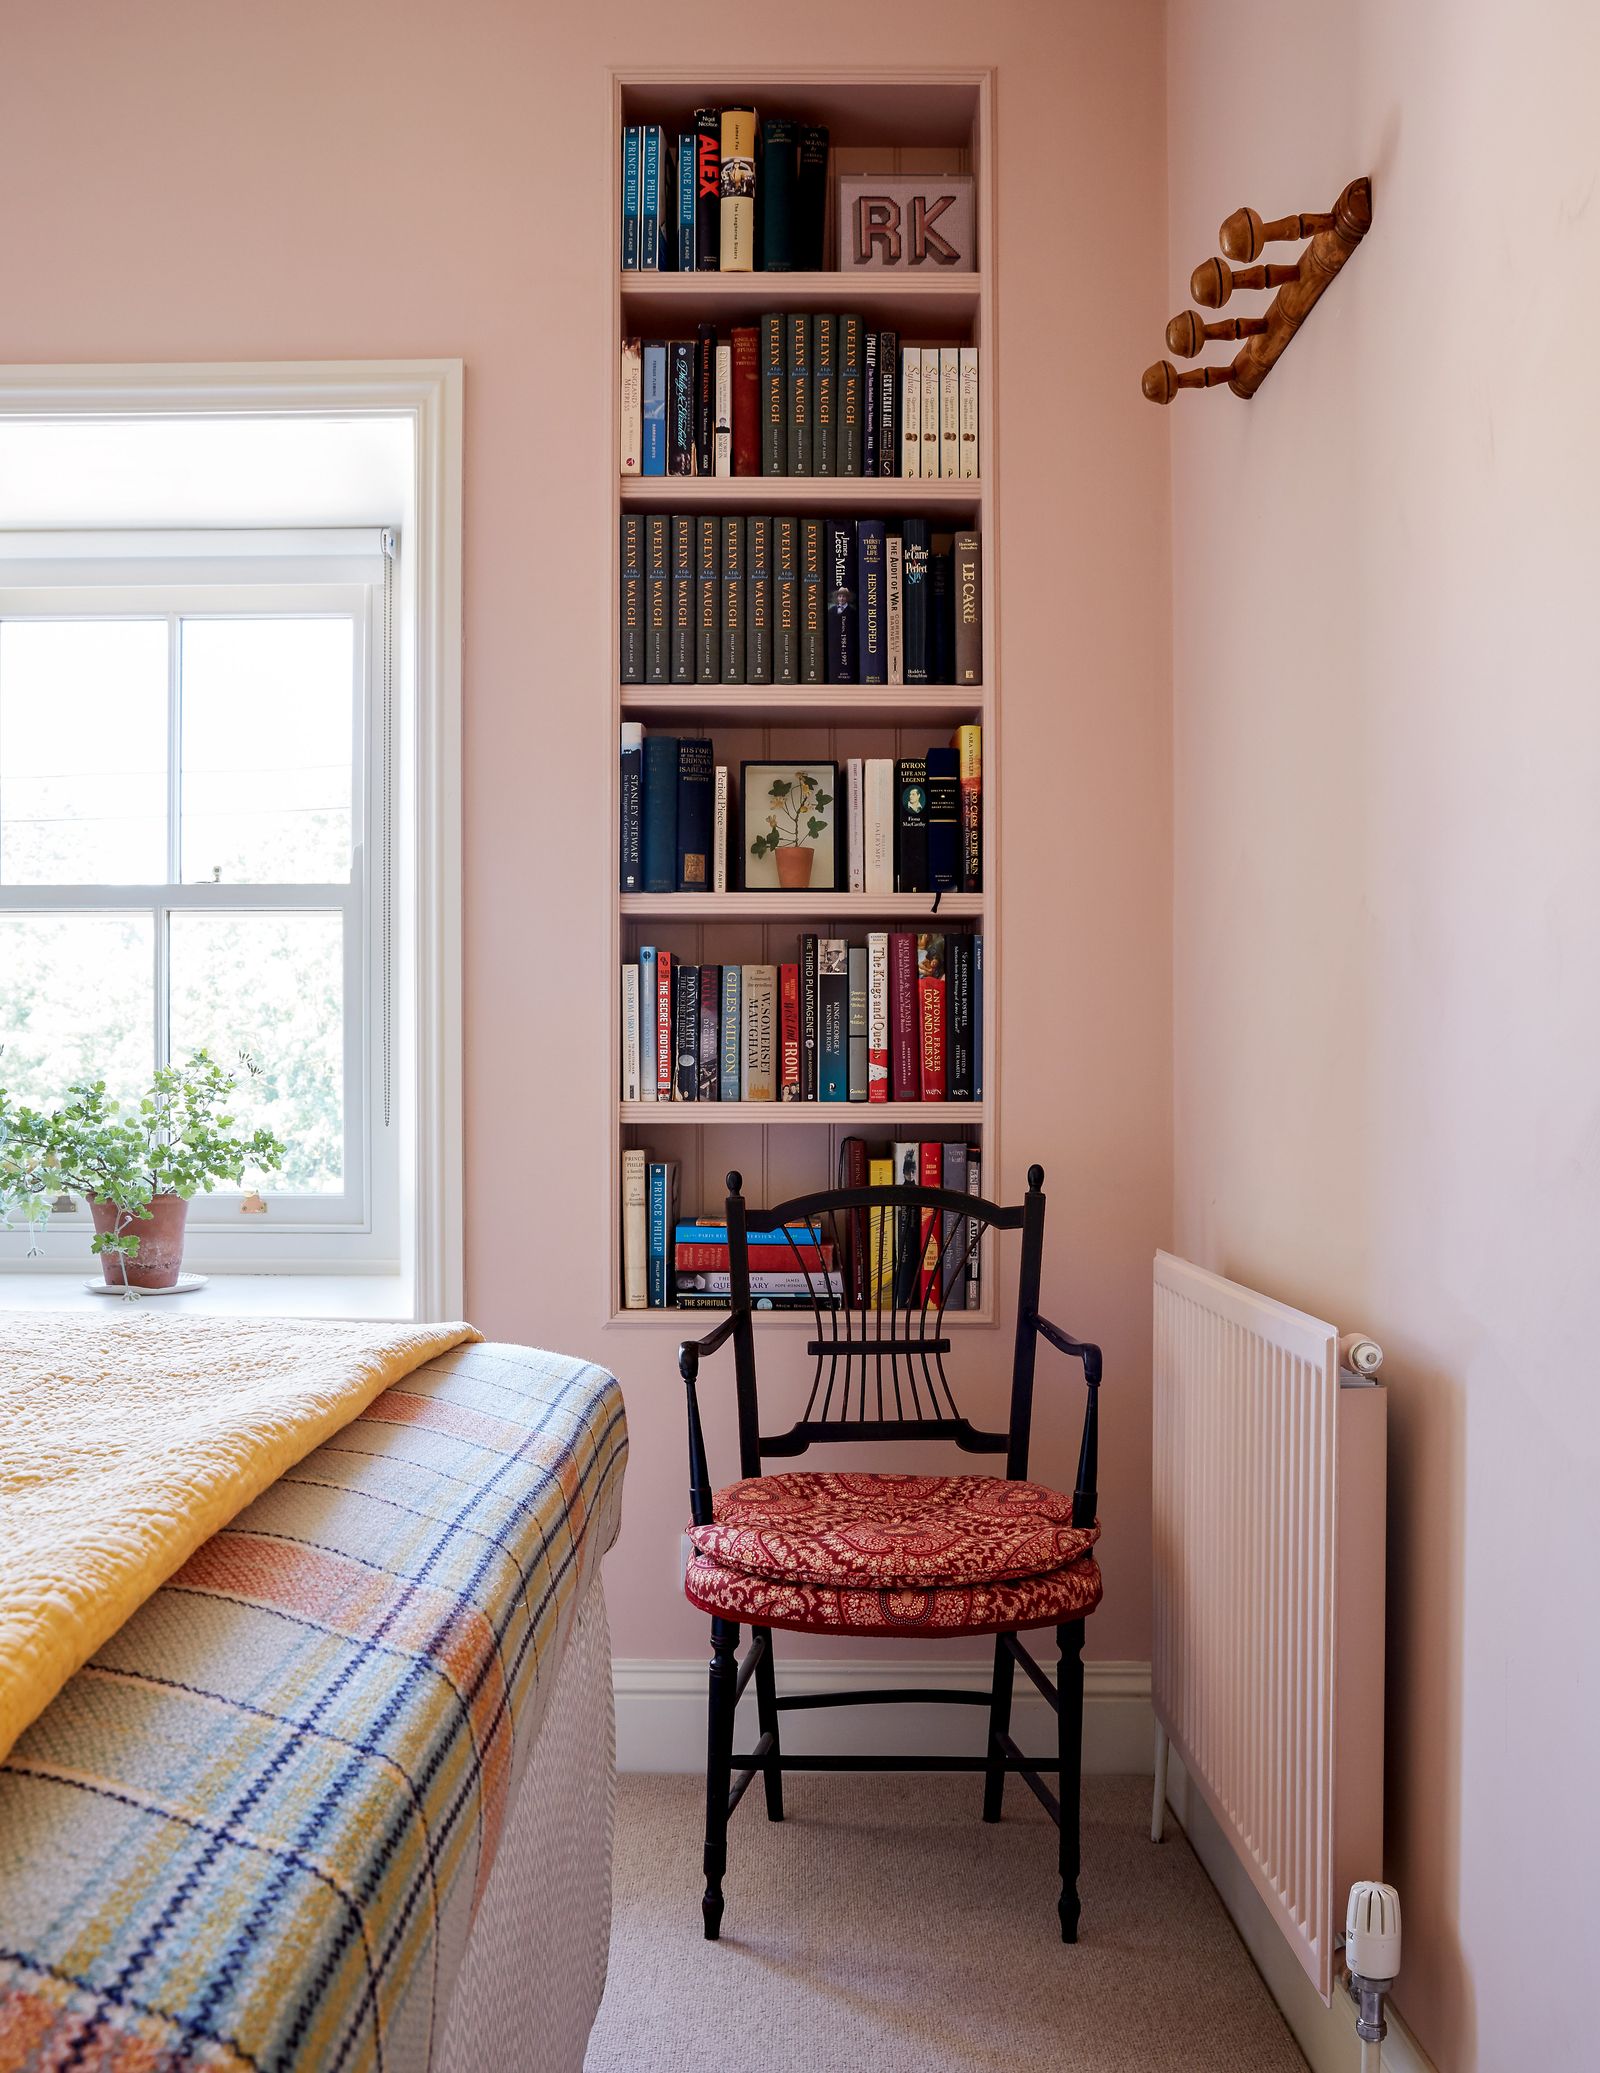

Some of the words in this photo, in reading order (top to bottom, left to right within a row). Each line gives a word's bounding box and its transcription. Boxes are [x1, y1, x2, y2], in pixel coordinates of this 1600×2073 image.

[627, 141, 637, 175] PRINCE
[647, 140, 656, 175] PRINCE
[683, 150, 692, 184] PRINCE
[699, 133, 720, 199] ALEX
[627, 179, 637, 211] PHILIP
[647, 179, 656, 211] PHILIP
[683, 188, 692, 220] PHILIP
[853, 196, 961, 266] RK
[770, 319, 780, 365] EVELYN
[796, 320, 805, 365] EVELYN
[821, 320, 830, 366] EVELYN
[847, 320, 856, 367] EVELYN
[866, 337, 877, 367] PHILIP
[675, 359, 688, 393] Philip
[719, 351, 728, 385] DIANA
[905, 365, 920, 394] Sylvia
[923, 366, 938, 394] Sylvia
[943, 364, 957, 393] Sylvia
[961, 366, 976, 395] Sylvia
[770, 377, 780, 423] WAUGH
[796, 378, 805, 423] WAUGH
[821, 378, 830, 424] WAUGH
[847, 379, 856, 424] WAUGH
[882, 374, 893, 413] GENTLEMAN
[677, 399, 688, 450] Elizabeth
[882, 413, 893, 428] JACK
[627, 521, 635, 568] EVELYN
[653, 521, 662, 568] EVELYN
[679, 521, 688, 567] EVELYN
[703, 522, 713, 569] EVELYN
[728, 522, 737, 569] EVELYN
[755, 521, 764, 568] EVELYN
[782, 523, 791, 570] EVELYN
[808, 525, 817, 572] EVELYN
[834, 531, 845, 587] Lees-Milne
[841, 537, 850, 556] James
[890, 541, 898, 555] THE
[904, 549, 911, 560] le
[911, 549, 929, 560] Carré
[910, 543, 922, 553] John
[890, 556, 899, 579] AUDIT
[905, 561, 928, 574] Perfect
[962, 563, 975, 581] LE
[627, 580, 635, 625] WAUGH
[653, 580, 662, 626] WAUGH
[679, 580, 688, 626] WAUGH
[755, 580, 764, 626] WAUGH
[868, 573, 877, 606] HENRY
[890, 581, 898, 590] OF
[890, 591, 899, 611] WAR
[703, 581, 713, 627] WAUGH
[728, 582, 737, 628] WAUGH
[782, 582, 791, 628] WAUGH
[808, 584, 817, 630] WAUGH
[962, 583, 977, 624] CARRÉ
[868, 608, 877, 653] BLOFELD
[901, 762, 926, 770] BYRON
[630, 774, 639, 816] STANLEY
[717, 771, 726, 800] Period
[970, 788, 979, 804] TOO
[717, 802, 726, 826] Piece
[970, 805, 979, 828] CLOSE
[630, 820, 639, 863] STEWART
[970, 840, 979, 857] THE
[970, 857, 979, 875] SUN
[805, 950, 814, 977] THIRD
[873, 948, 885, 968] The
[903, 940, 911, 980] MICHAEL
[627, 969, 635, 991] VIEWS
[659, 980, 668, 995] THE
[686, 976, 695, 1012] DONNA
[726, 972, 737, 1013] GILES
[871, 970, 886, 999] Kings
[627, 992, 635, 1013] FROM
[659, 998, 668, 1028] SECRET
[784, 1002, 796, 1024] West
[805, 979, 814, 1038] PLANTAGENET
[873, 1001, 885, 1020] and
[903, 992, 911, 1033] NATASHA
[924, 989, 933, 1011] LOVE
[933, 989, 941, 1033] ANTONIA
[627, 1013, 635, 1041] ABROAD
[686, 1015, 695, 1050] TARTT
[748, 998, 759, 1069] MAUGHAM
[924, 1012, 933, 1031] AND
[659, 1030, 668, 1078] FOOTBALLER
[709, 1046, 715, 1054] IN
[726, 1017, 737, 1074] MILTON
[871, 1022, 885, 1059] Queens
[924, 1032, 933, 1056] LOUIS
[933, 1037, 941, 1072] FRASER
[784, 1042, 798, 1082] FRONT
[924, 1056, 933, 1071] XIV
[654, 1181, 662, 1216] PRINCE
[654, 1220, 662, 1252] PHILIP
[684, 1299, 696, 1307] THE
[696, 1298, 728, 1307] SPIRITUAL
